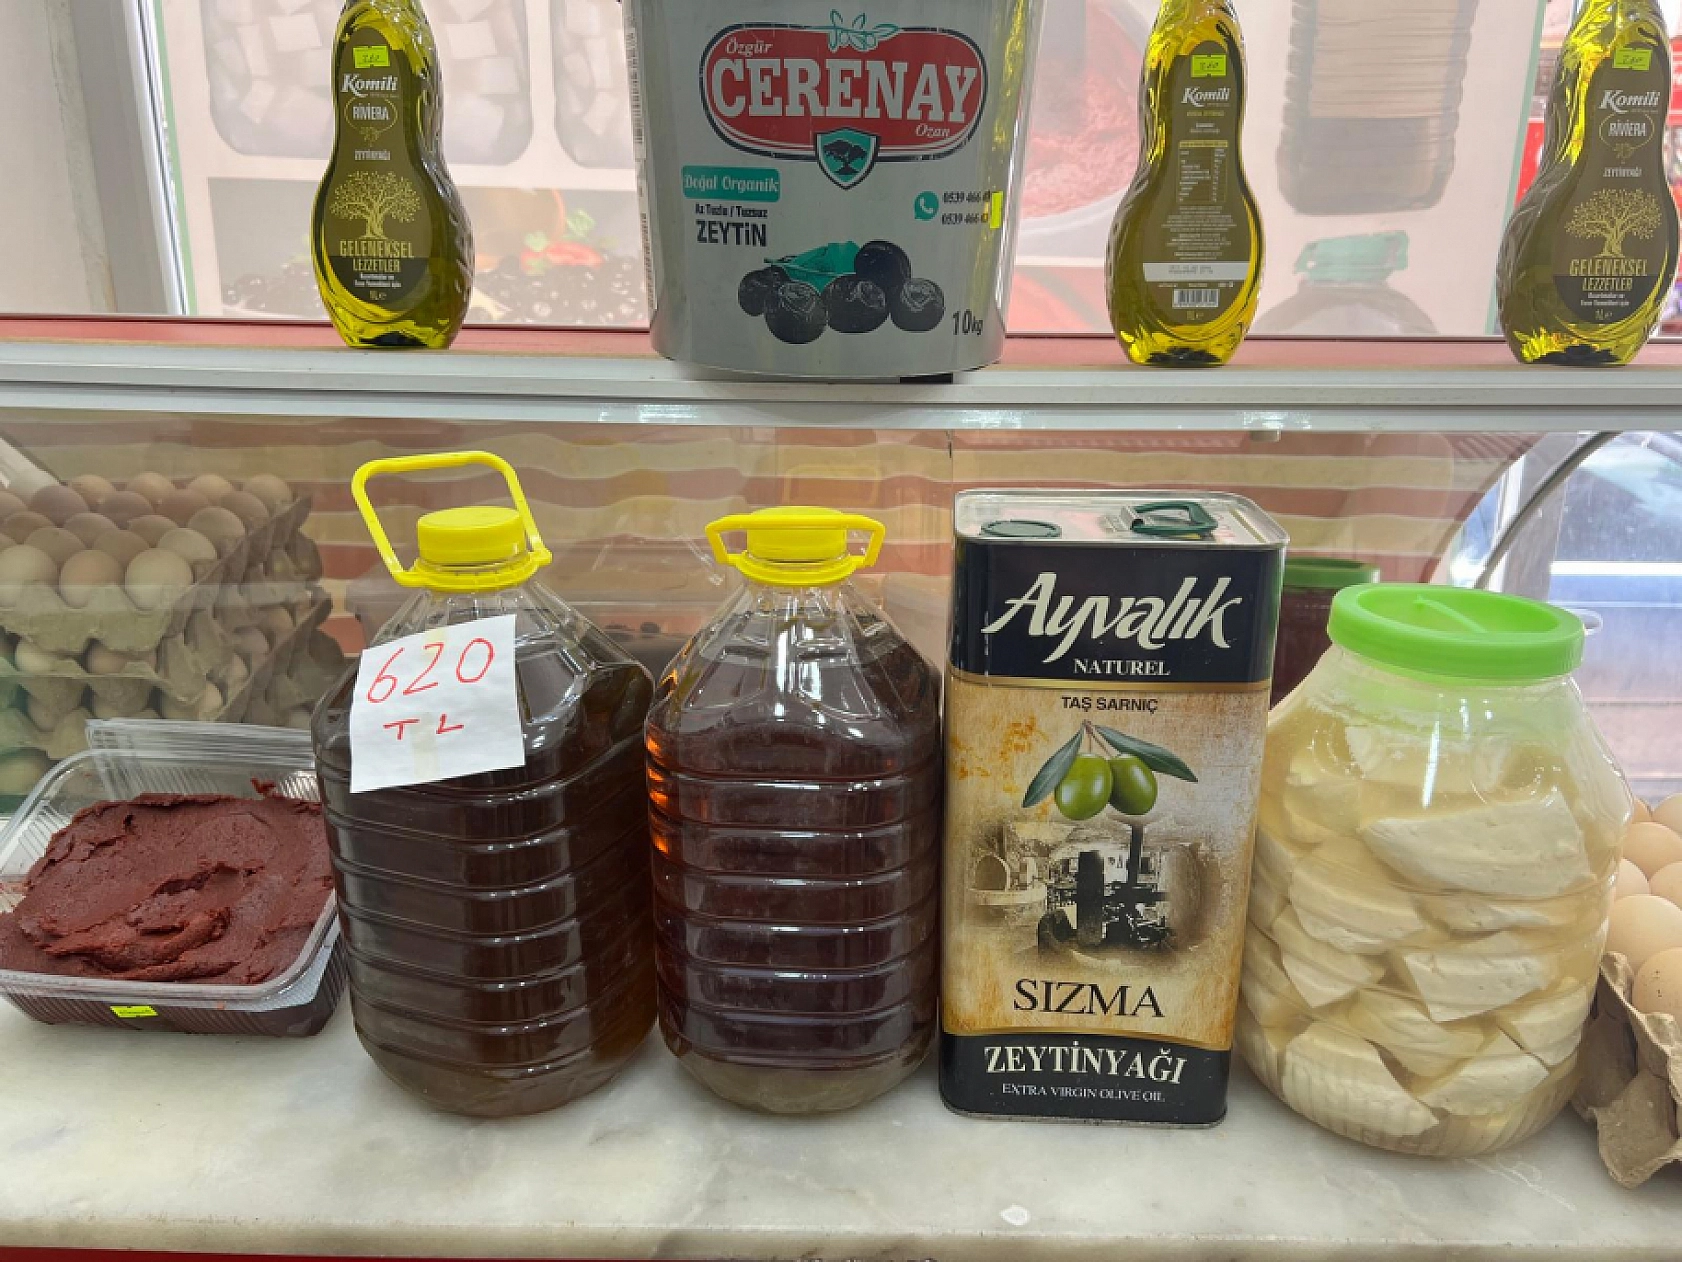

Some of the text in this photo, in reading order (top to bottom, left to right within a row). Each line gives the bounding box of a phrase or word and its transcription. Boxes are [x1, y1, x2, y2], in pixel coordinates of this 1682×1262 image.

[725, 37, 773, 58] Özgür
[340, 73, 398, 98] Komili
[711, 57, 978, 123] CERENAY
[1181, 86, 1231, 108] Komili
[1598, 89, 1660, 115] Komili
[915, 122, 951, 137] Ozan
[684, 174, 779, 194] Doğal Organik
[340, 239, 415, 259] GELENEKSEL
[353, 258, 400, 273] LEZZETLER
[1569, 258, 1648, 276] GELENEKSEL
[1582, 277, 1633, 292] LEZZETLER
[981, 571, 1242, 664] Ayvalık
[365, 637, 496, 704] 620
[1073, 658, 1171, 676] NATUREL
[1061, 696, 1159, 715] TAŞ SARNIÇ
[383, 713, 465, 741] TL
[1013, 978, 1166, 1018] SIZMA
[984, 1041, 1188, 1085] ZEYTİNYAĞI
[1002, 1083, 1166, 1103] EXTRA VIRGIN OLIVE OIL
